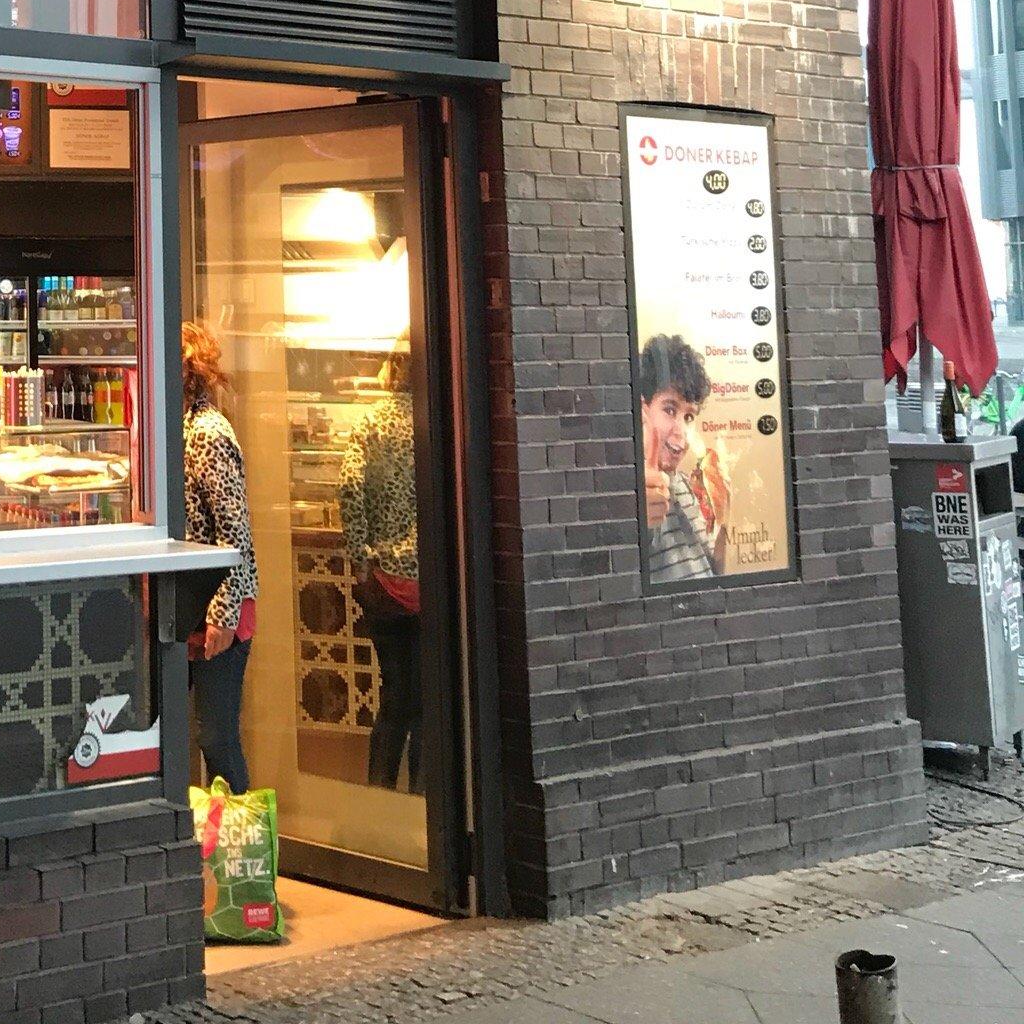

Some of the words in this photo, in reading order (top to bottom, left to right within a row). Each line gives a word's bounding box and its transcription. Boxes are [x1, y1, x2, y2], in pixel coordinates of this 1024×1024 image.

[716, 149, 758, 168] KEBAP
[705, 345, 729, 356] Döner
[732, 345, 748, 356] Box
[702, 421, 727, 432] Döner
[729, 418, 752, 430] Menü
[935, 495, 968, 514] BNE
[936, 515, 968, 525] WAS
[937, 525, 970, 536] HERE
[224, 859, 271, 878] NETZ.
